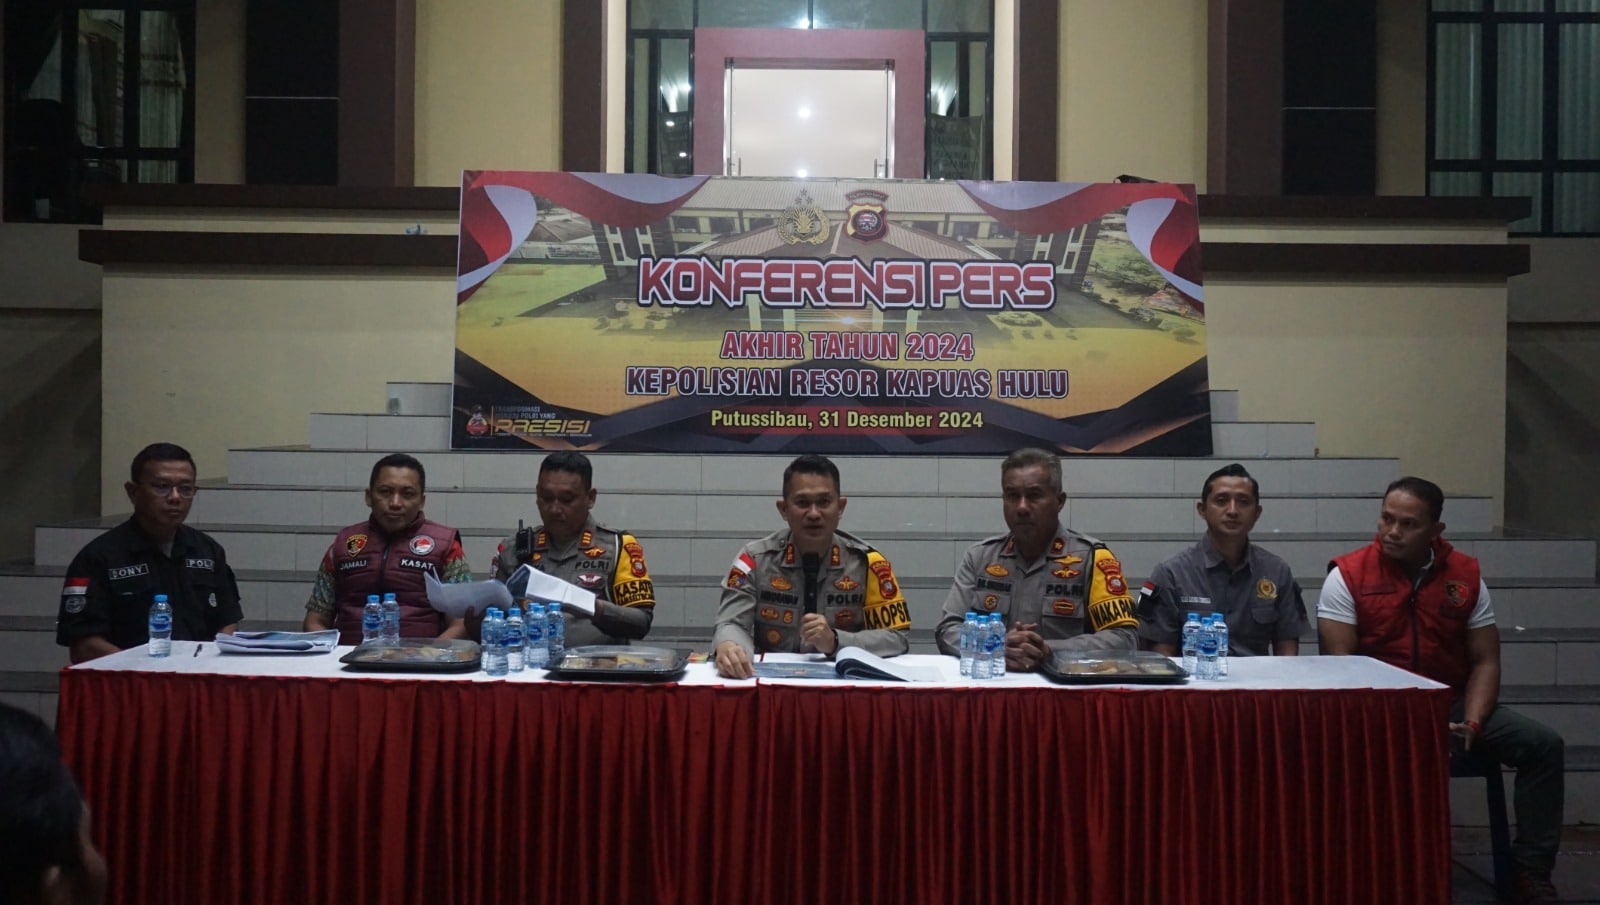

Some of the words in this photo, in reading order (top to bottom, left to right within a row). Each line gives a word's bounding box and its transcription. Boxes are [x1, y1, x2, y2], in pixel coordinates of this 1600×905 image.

[638, 258, 926, 309] KONFERENSI
[928, 263, 1056, 310] PERS
[721, 331, 804, 360] AKHIR
[809, 332, 899, 361] TAHUN
[904, 333, 975, 362] 2024
[625, 366, 781, 396] KEPOLISIAN
[788, 368, 879, 398] RESOR
[885, 369, 992, 399] KAPUAS
[996, 370, 1069, 400] HULU
[710, 409, 813, 430] Putussibau,
[818, 411, 840, 428] 31
[847, 411, 933, 429] Desember
[938, 411, 984, 429] 2024
[575, 560, 610, 570] POLRI
[827, 593, 863, 606] POLRI
